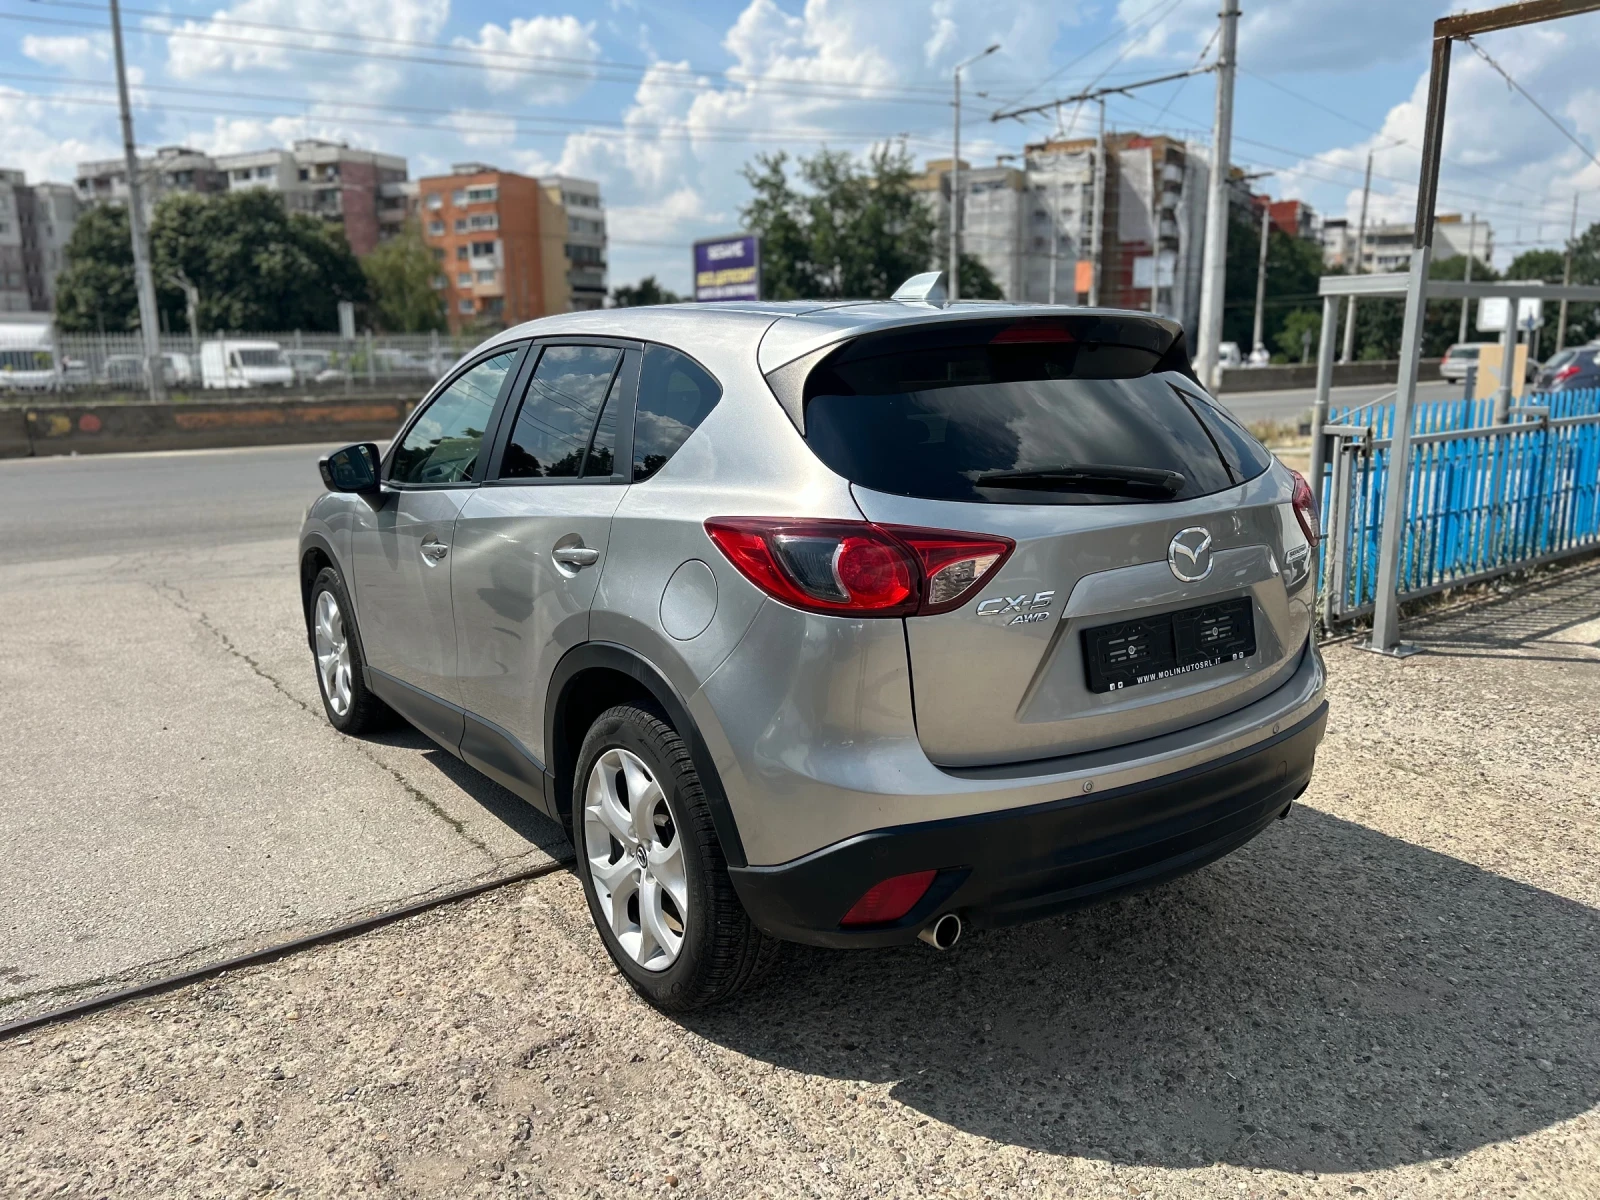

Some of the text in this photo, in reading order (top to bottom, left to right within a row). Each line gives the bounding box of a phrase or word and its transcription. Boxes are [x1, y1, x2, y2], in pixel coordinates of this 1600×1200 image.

[976, 590, 1055, 616] CX-5
[1008, 611, 1050, 626] AWD
[1136, 657, 1221, 684] WWW.MOLINAUTOSRL.IT
